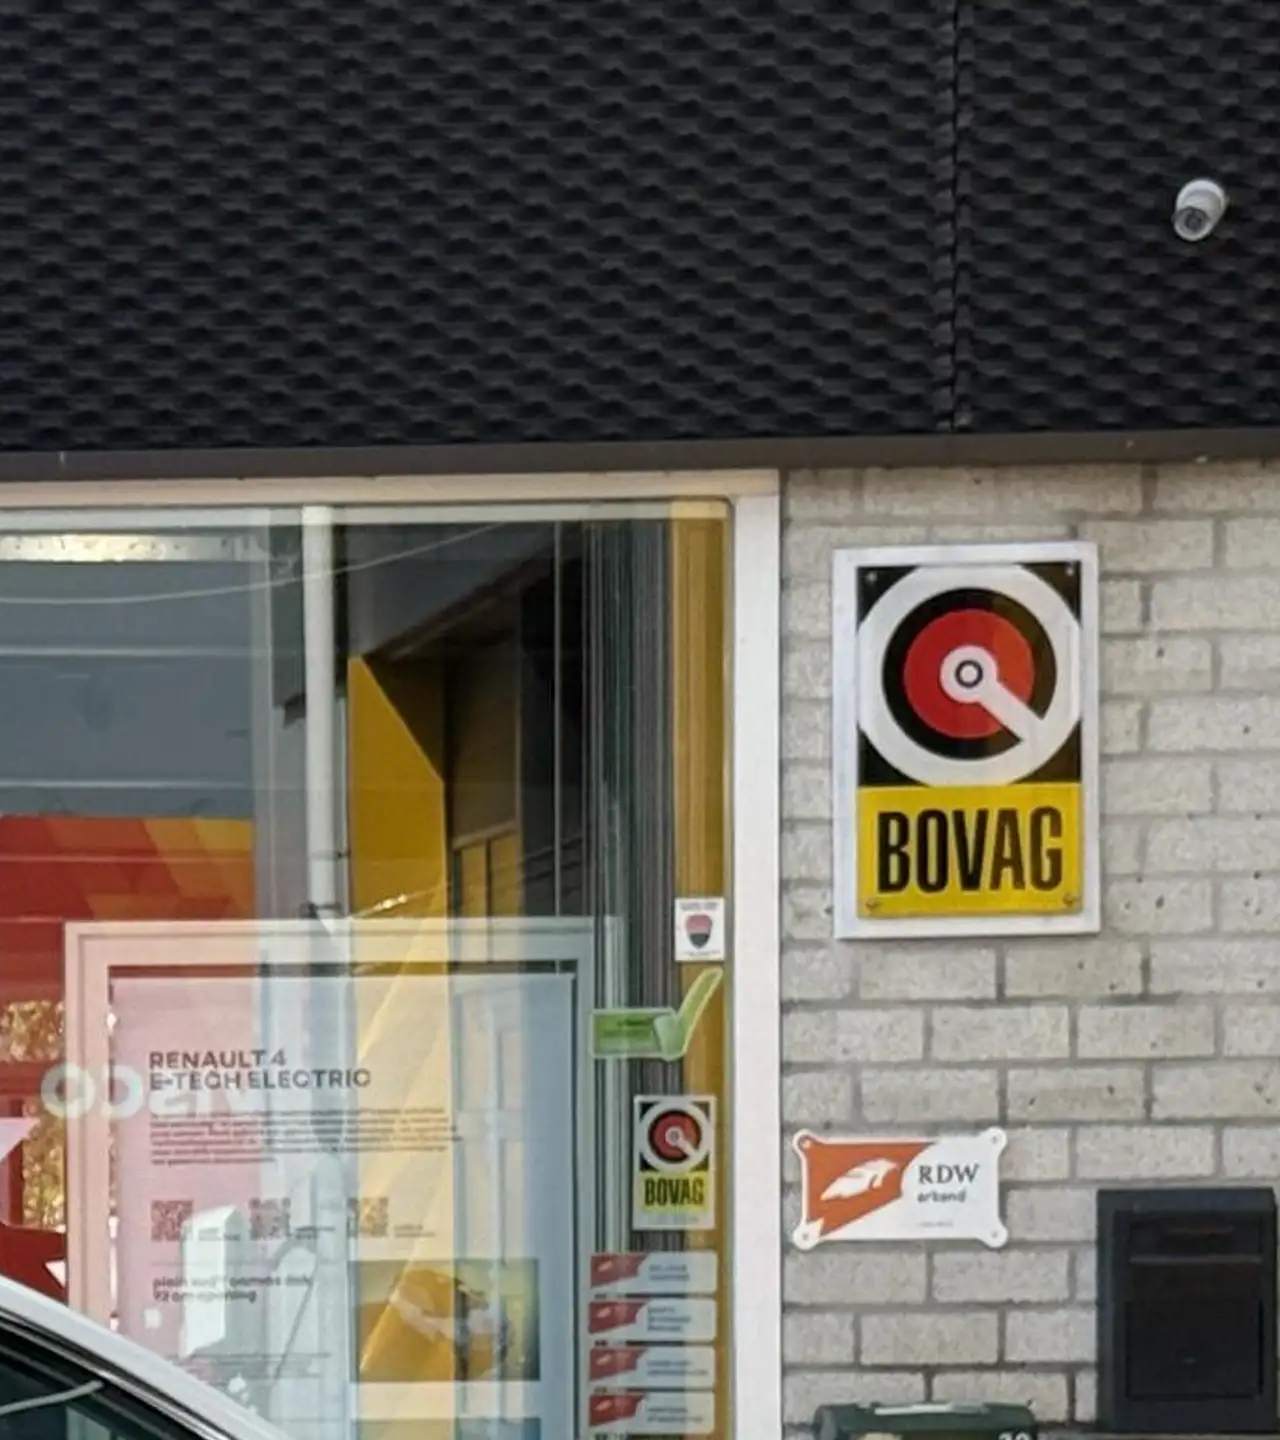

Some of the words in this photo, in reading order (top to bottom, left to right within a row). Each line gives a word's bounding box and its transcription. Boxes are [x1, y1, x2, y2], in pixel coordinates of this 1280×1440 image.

[877, 806, 1063, 894] BOVAG
[149, 1050, 266, 1069] RENAULT
[271, 1050, 286, 1066] 4
[150, 1069, 241, 1090] E-TECH
[248, 1068, 371, 1089] ELECTRIC
[919, 1163, 980, 1184] RDW
[644, 1177, 704, 1206] BOVAG
